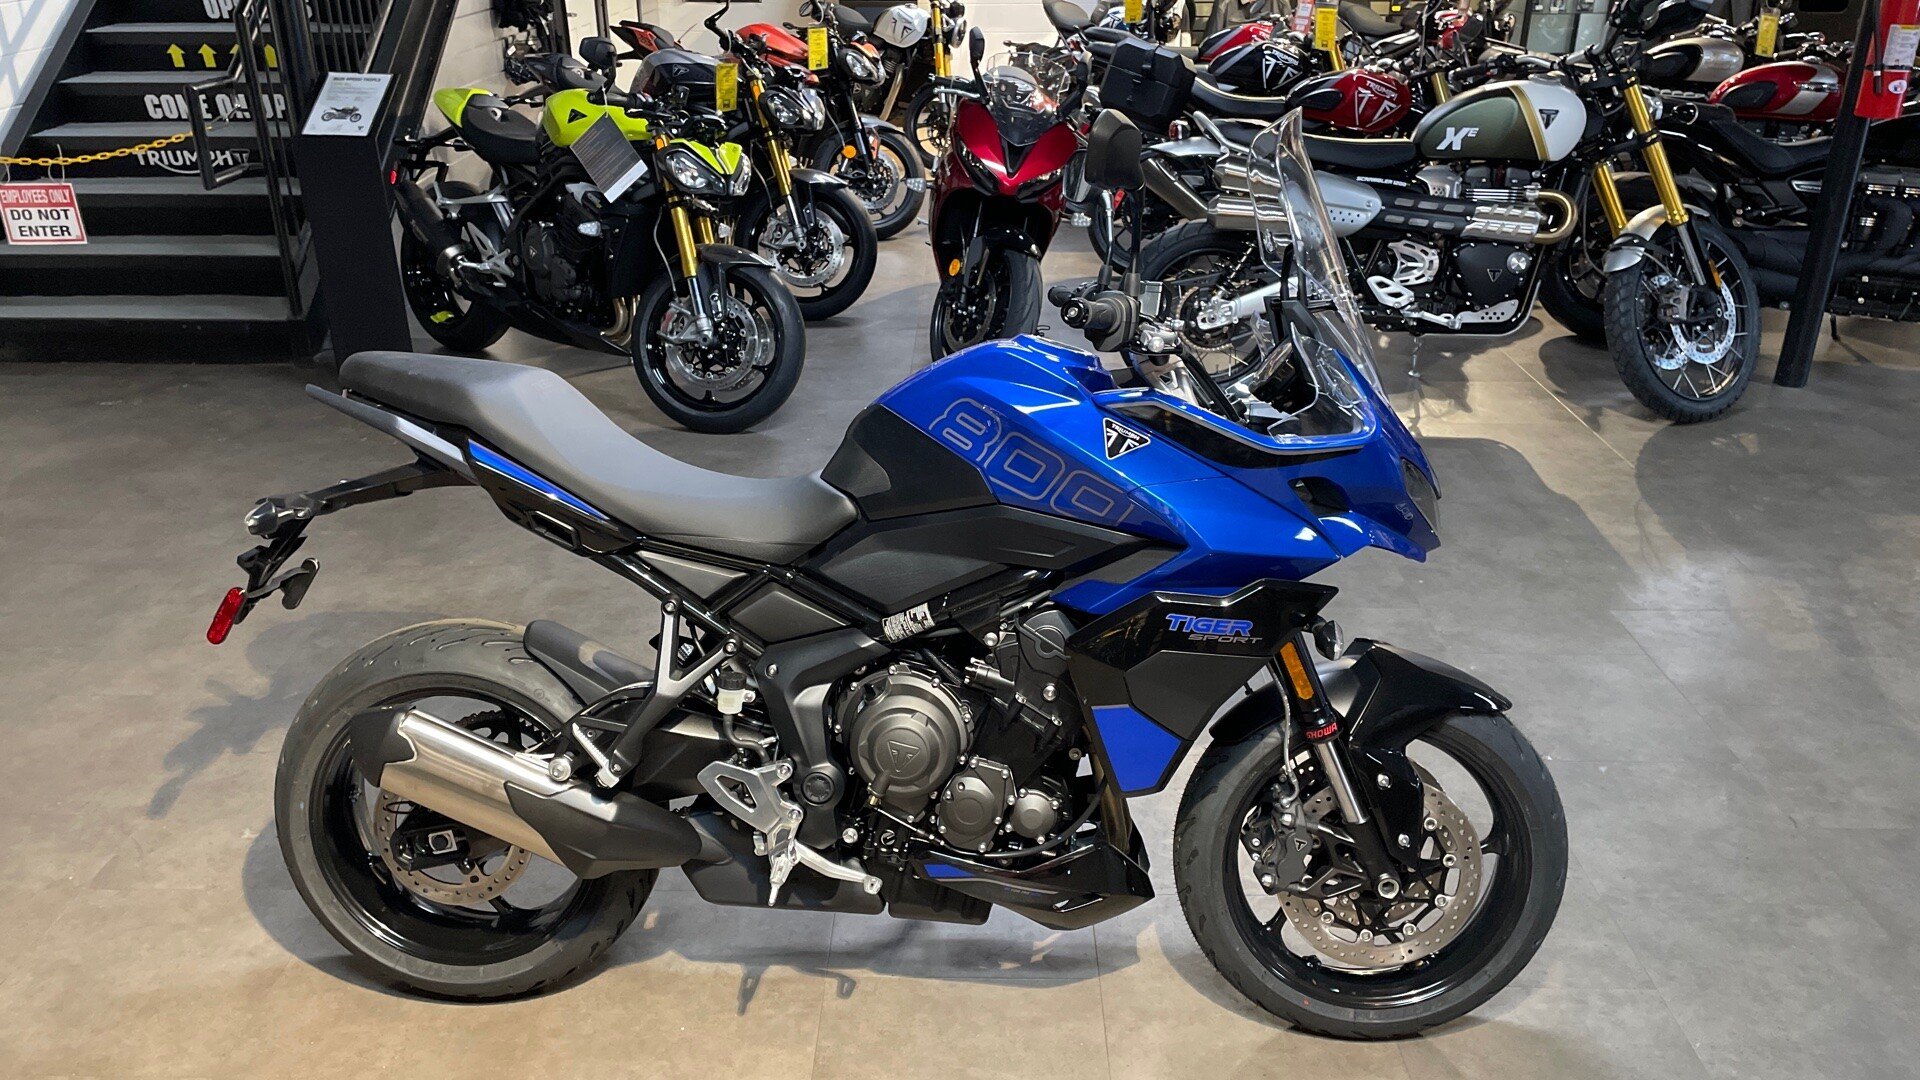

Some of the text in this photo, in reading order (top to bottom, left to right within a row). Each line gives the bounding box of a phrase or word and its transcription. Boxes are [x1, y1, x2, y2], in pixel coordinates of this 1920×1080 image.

[0, 189, 71, 204] EMPLOYEES ONLY
[10, 208, 70, 221] DO NOT
[18, 225, 72, 238] ENTER
[1111, 423, 1141, 441] TRIUMPH
[928, 397, 1135, 527] 800
[1166, 613, 1254, 637] TIGER
[1188, 634, 1263, 645] SPORT
[1306, 722, 1338, 740] SHOWA
